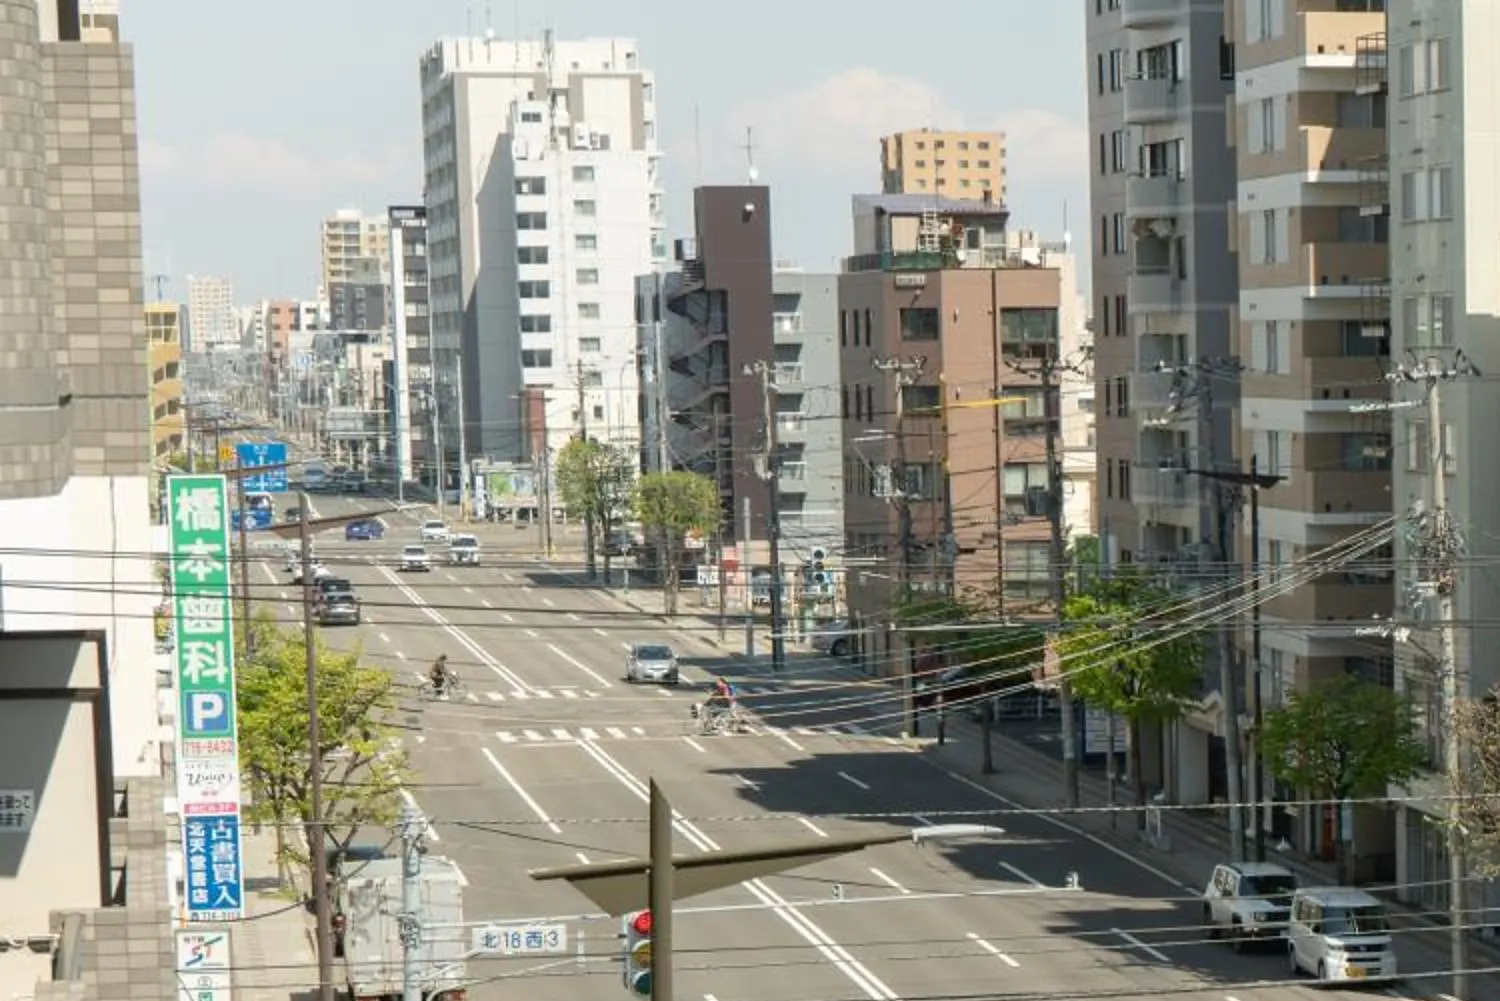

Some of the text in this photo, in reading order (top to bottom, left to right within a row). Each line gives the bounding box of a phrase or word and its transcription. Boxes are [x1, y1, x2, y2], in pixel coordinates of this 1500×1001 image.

[175, 487, 229, 685] 橋本歯科
[191, 693, 224, 730] P
[212, 819, 239, 907] 古書買入
